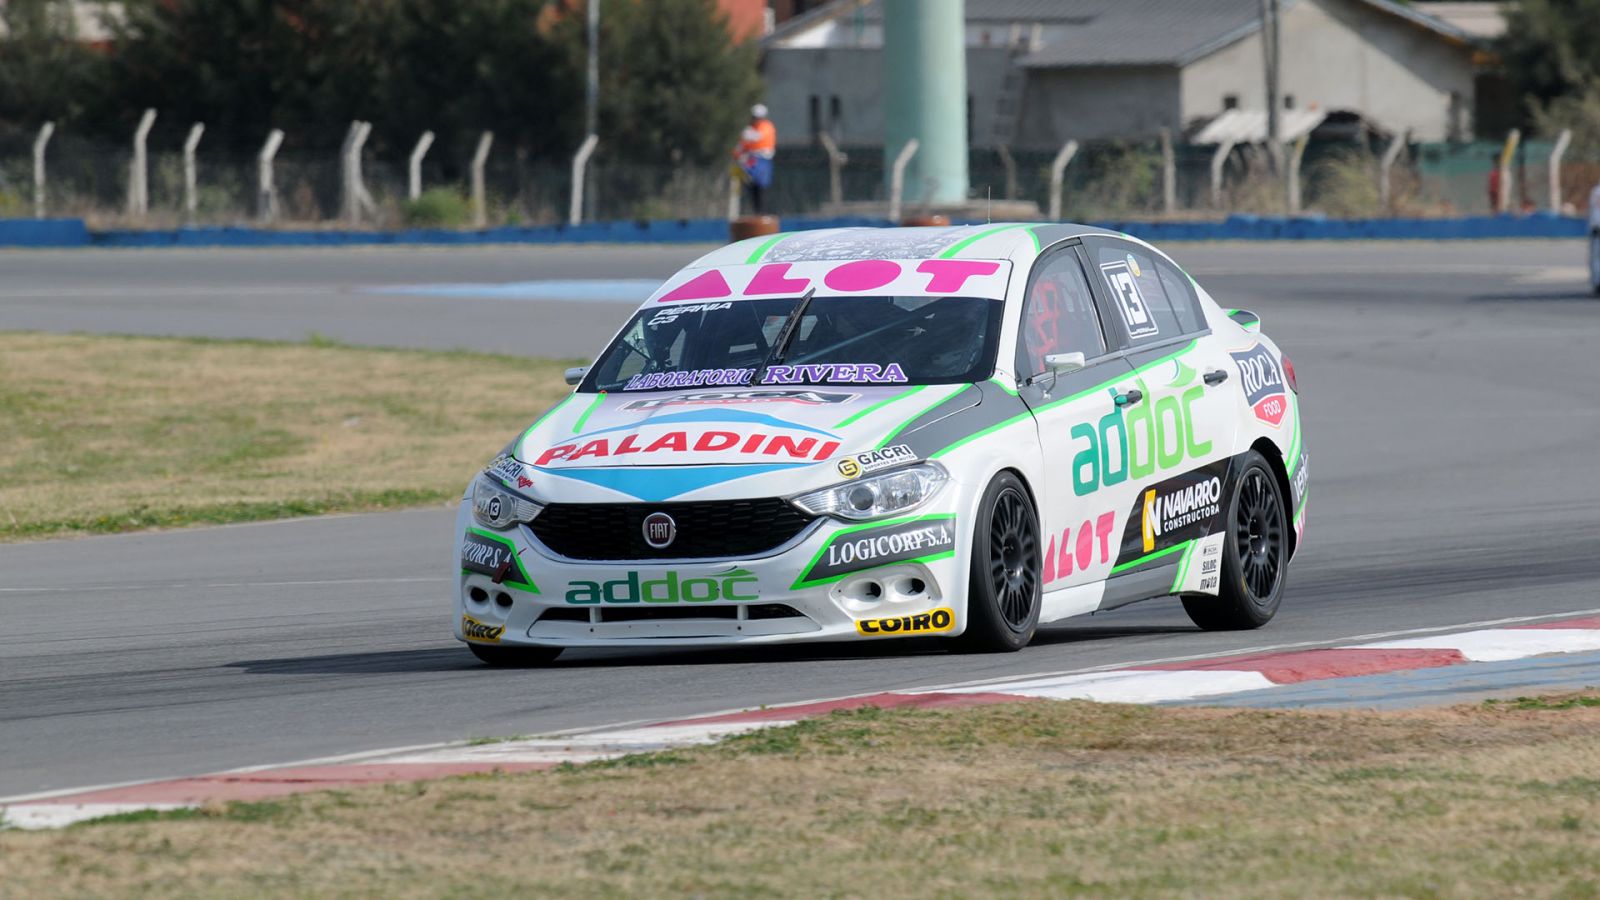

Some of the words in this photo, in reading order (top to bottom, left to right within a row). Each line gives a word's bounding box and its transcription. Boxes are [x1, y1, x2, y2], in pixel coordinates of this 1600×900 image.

[657, 260, 1000, 302] ALOT
[655, 302, 733, 317] PERNIA
[1110, 272, 1148, 326] 13
[762, 364, 908, 383] RIVERA
[1237, 351, 1282, 397] ROCA
[1263, 400, 1281, 418] FOOD
[534, 431, 841, 465] PALADINI
[1070, 378, 1213, 497] addoc
[857, 445, 912, 465] GACRI
[1163, 476, 1221, 521] NAVARRO
[650, 523, 669, 539] FIAT
[1164, 504, 1220, 532] CONSTRUCTORA
[828, 530, 923, 567] LOGICORP
[1042, 510, 1116, 585] ALOT
[565, 571, 759, 604] addoc
[860, 610, 951, 633] COIRO
